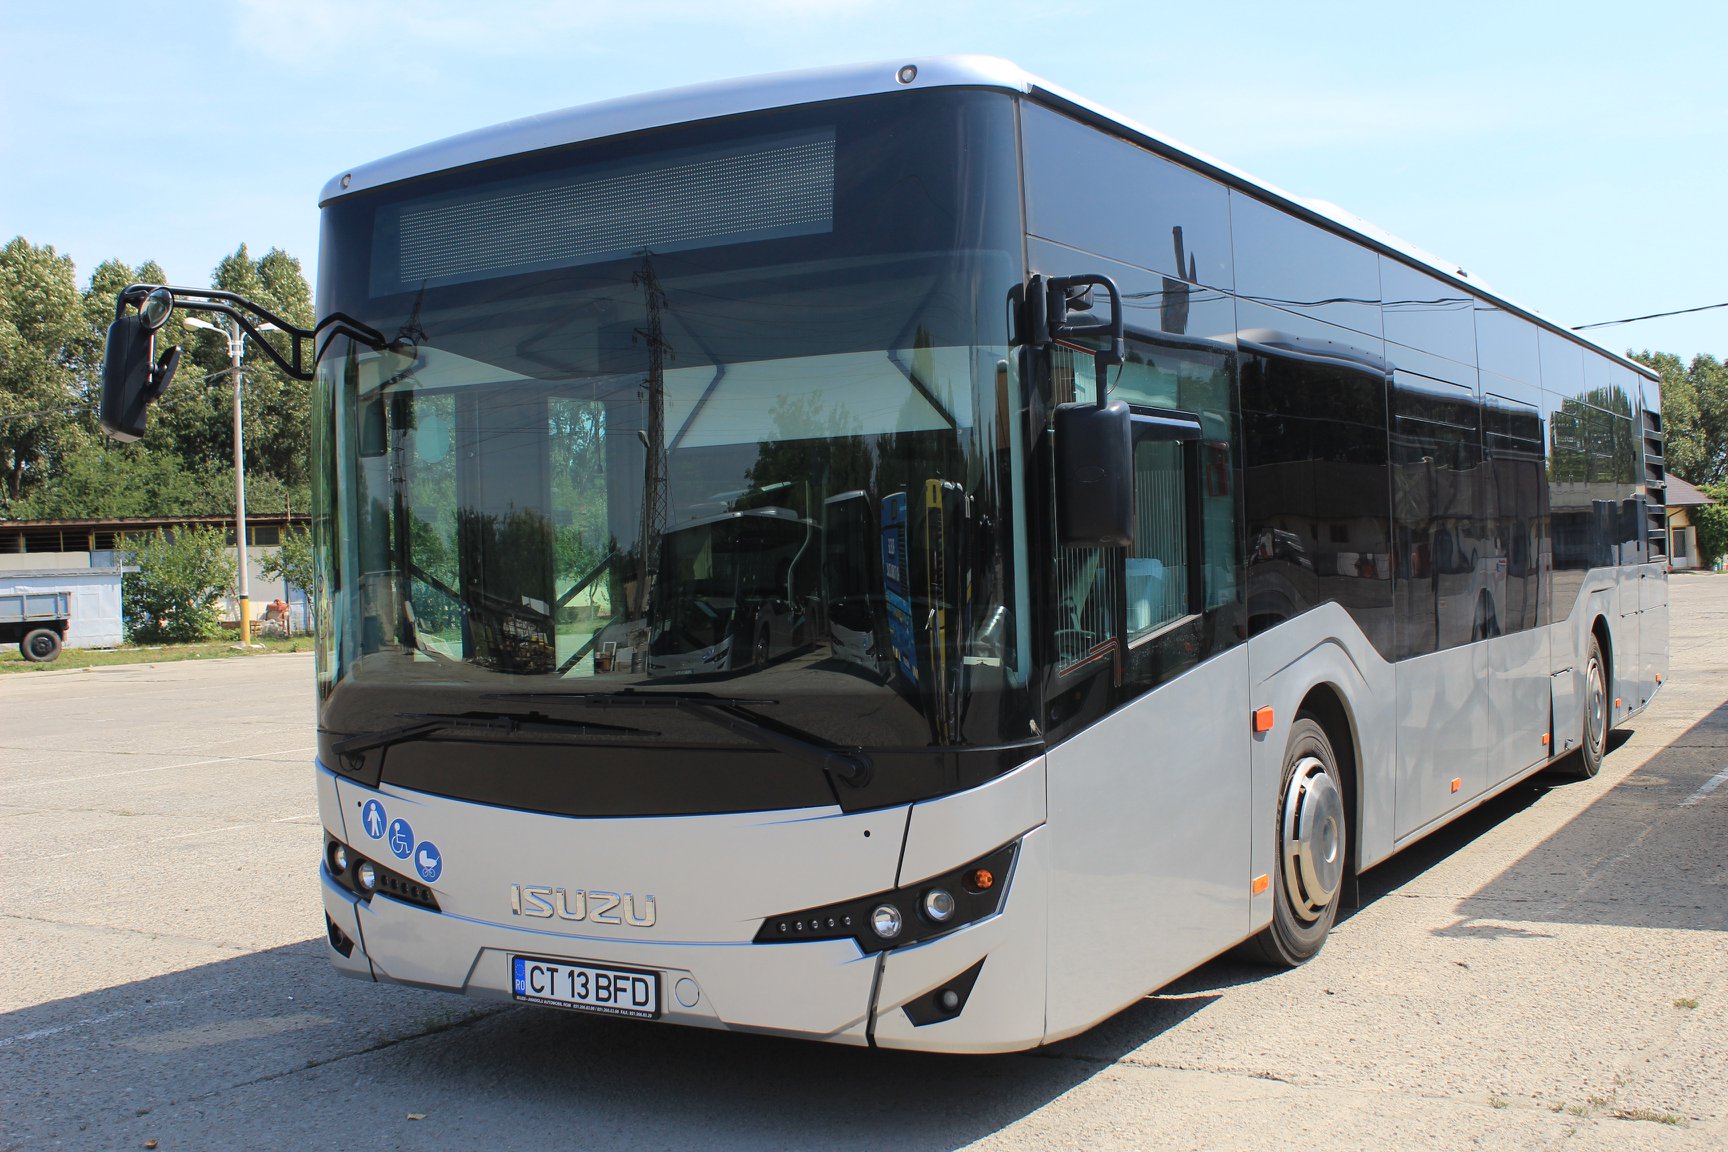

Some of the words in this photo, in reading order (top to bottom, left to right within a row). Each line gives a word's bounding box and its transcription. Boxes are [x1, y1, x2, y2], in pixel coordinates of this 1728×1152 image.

[511, 883, 656, 927] ISUZU
[515, 979, 525, 991] RO
[530, 965, 558, 995] CT
[568, 969, 590, 999] 13
[595, 973, 649, 1006] BFD
